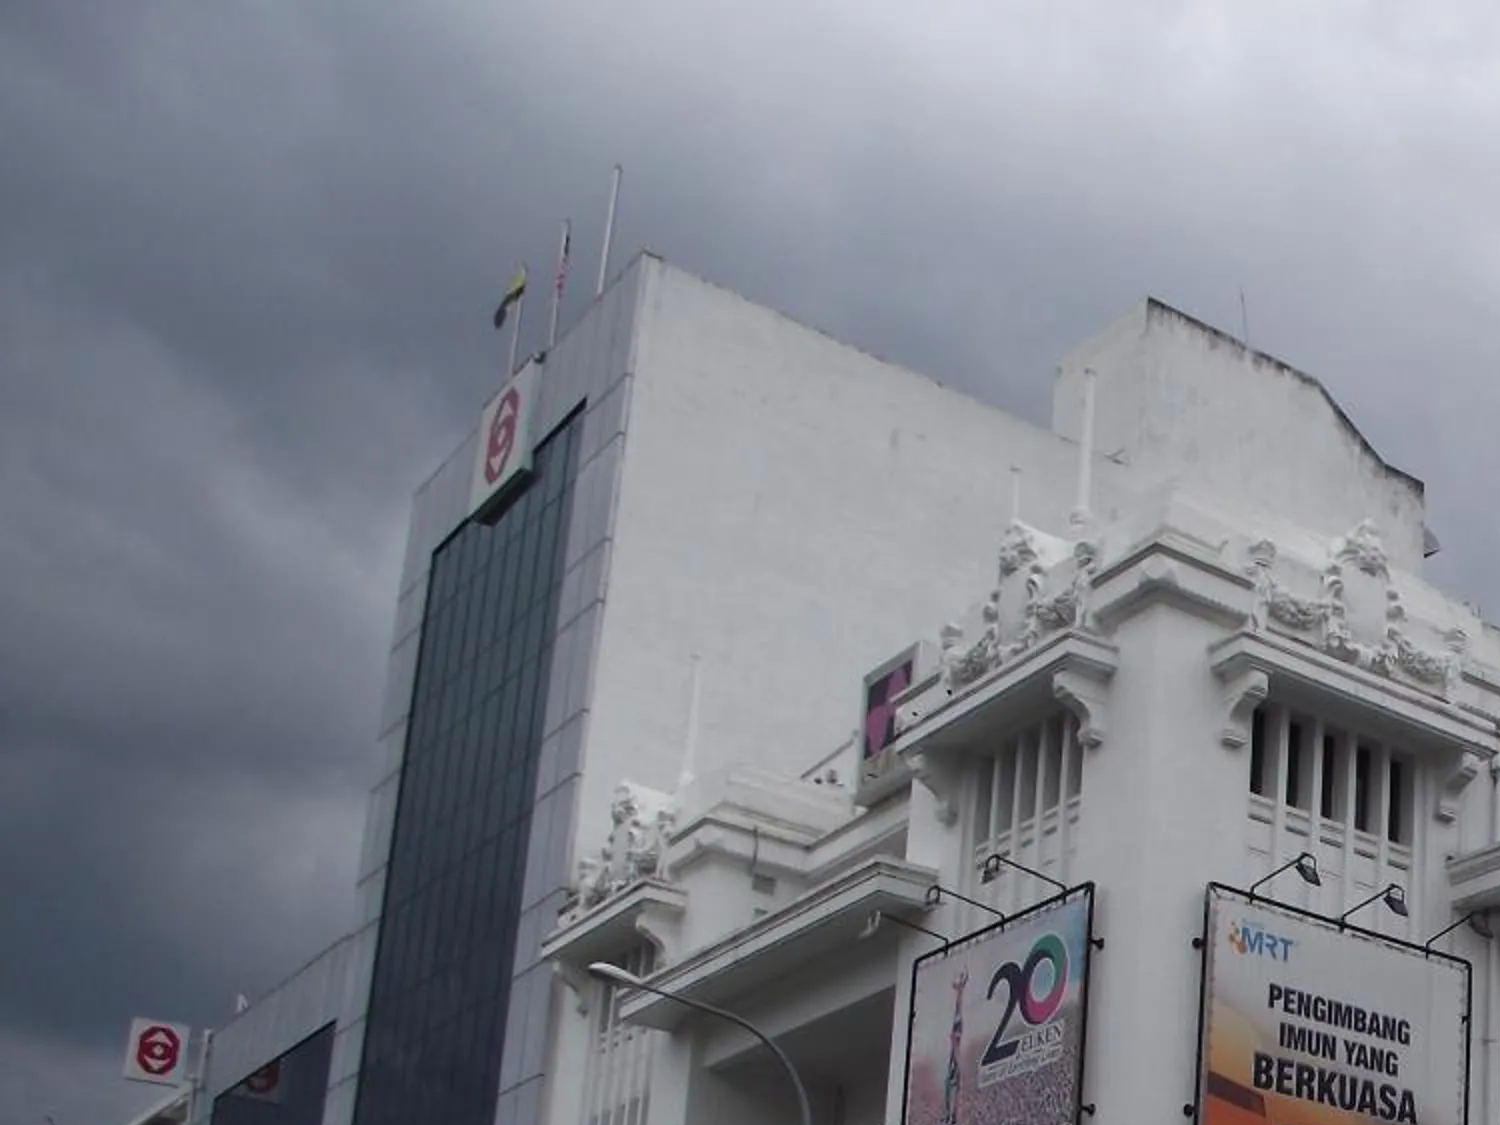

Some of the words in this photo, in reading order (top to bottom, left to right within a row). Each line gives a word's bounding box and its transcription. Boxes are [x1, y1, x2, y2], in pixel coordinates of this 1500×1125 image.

[1241, 927, 1294, 962] MRT
[1268, 982, 1411, 1046] PENGIMBANG
[1279, 1022, 1337, 1061] IMUN
[1343, 1039, 1399, 1077] YANG
[1253, 1050, 1418, 1125] BERKUASA
